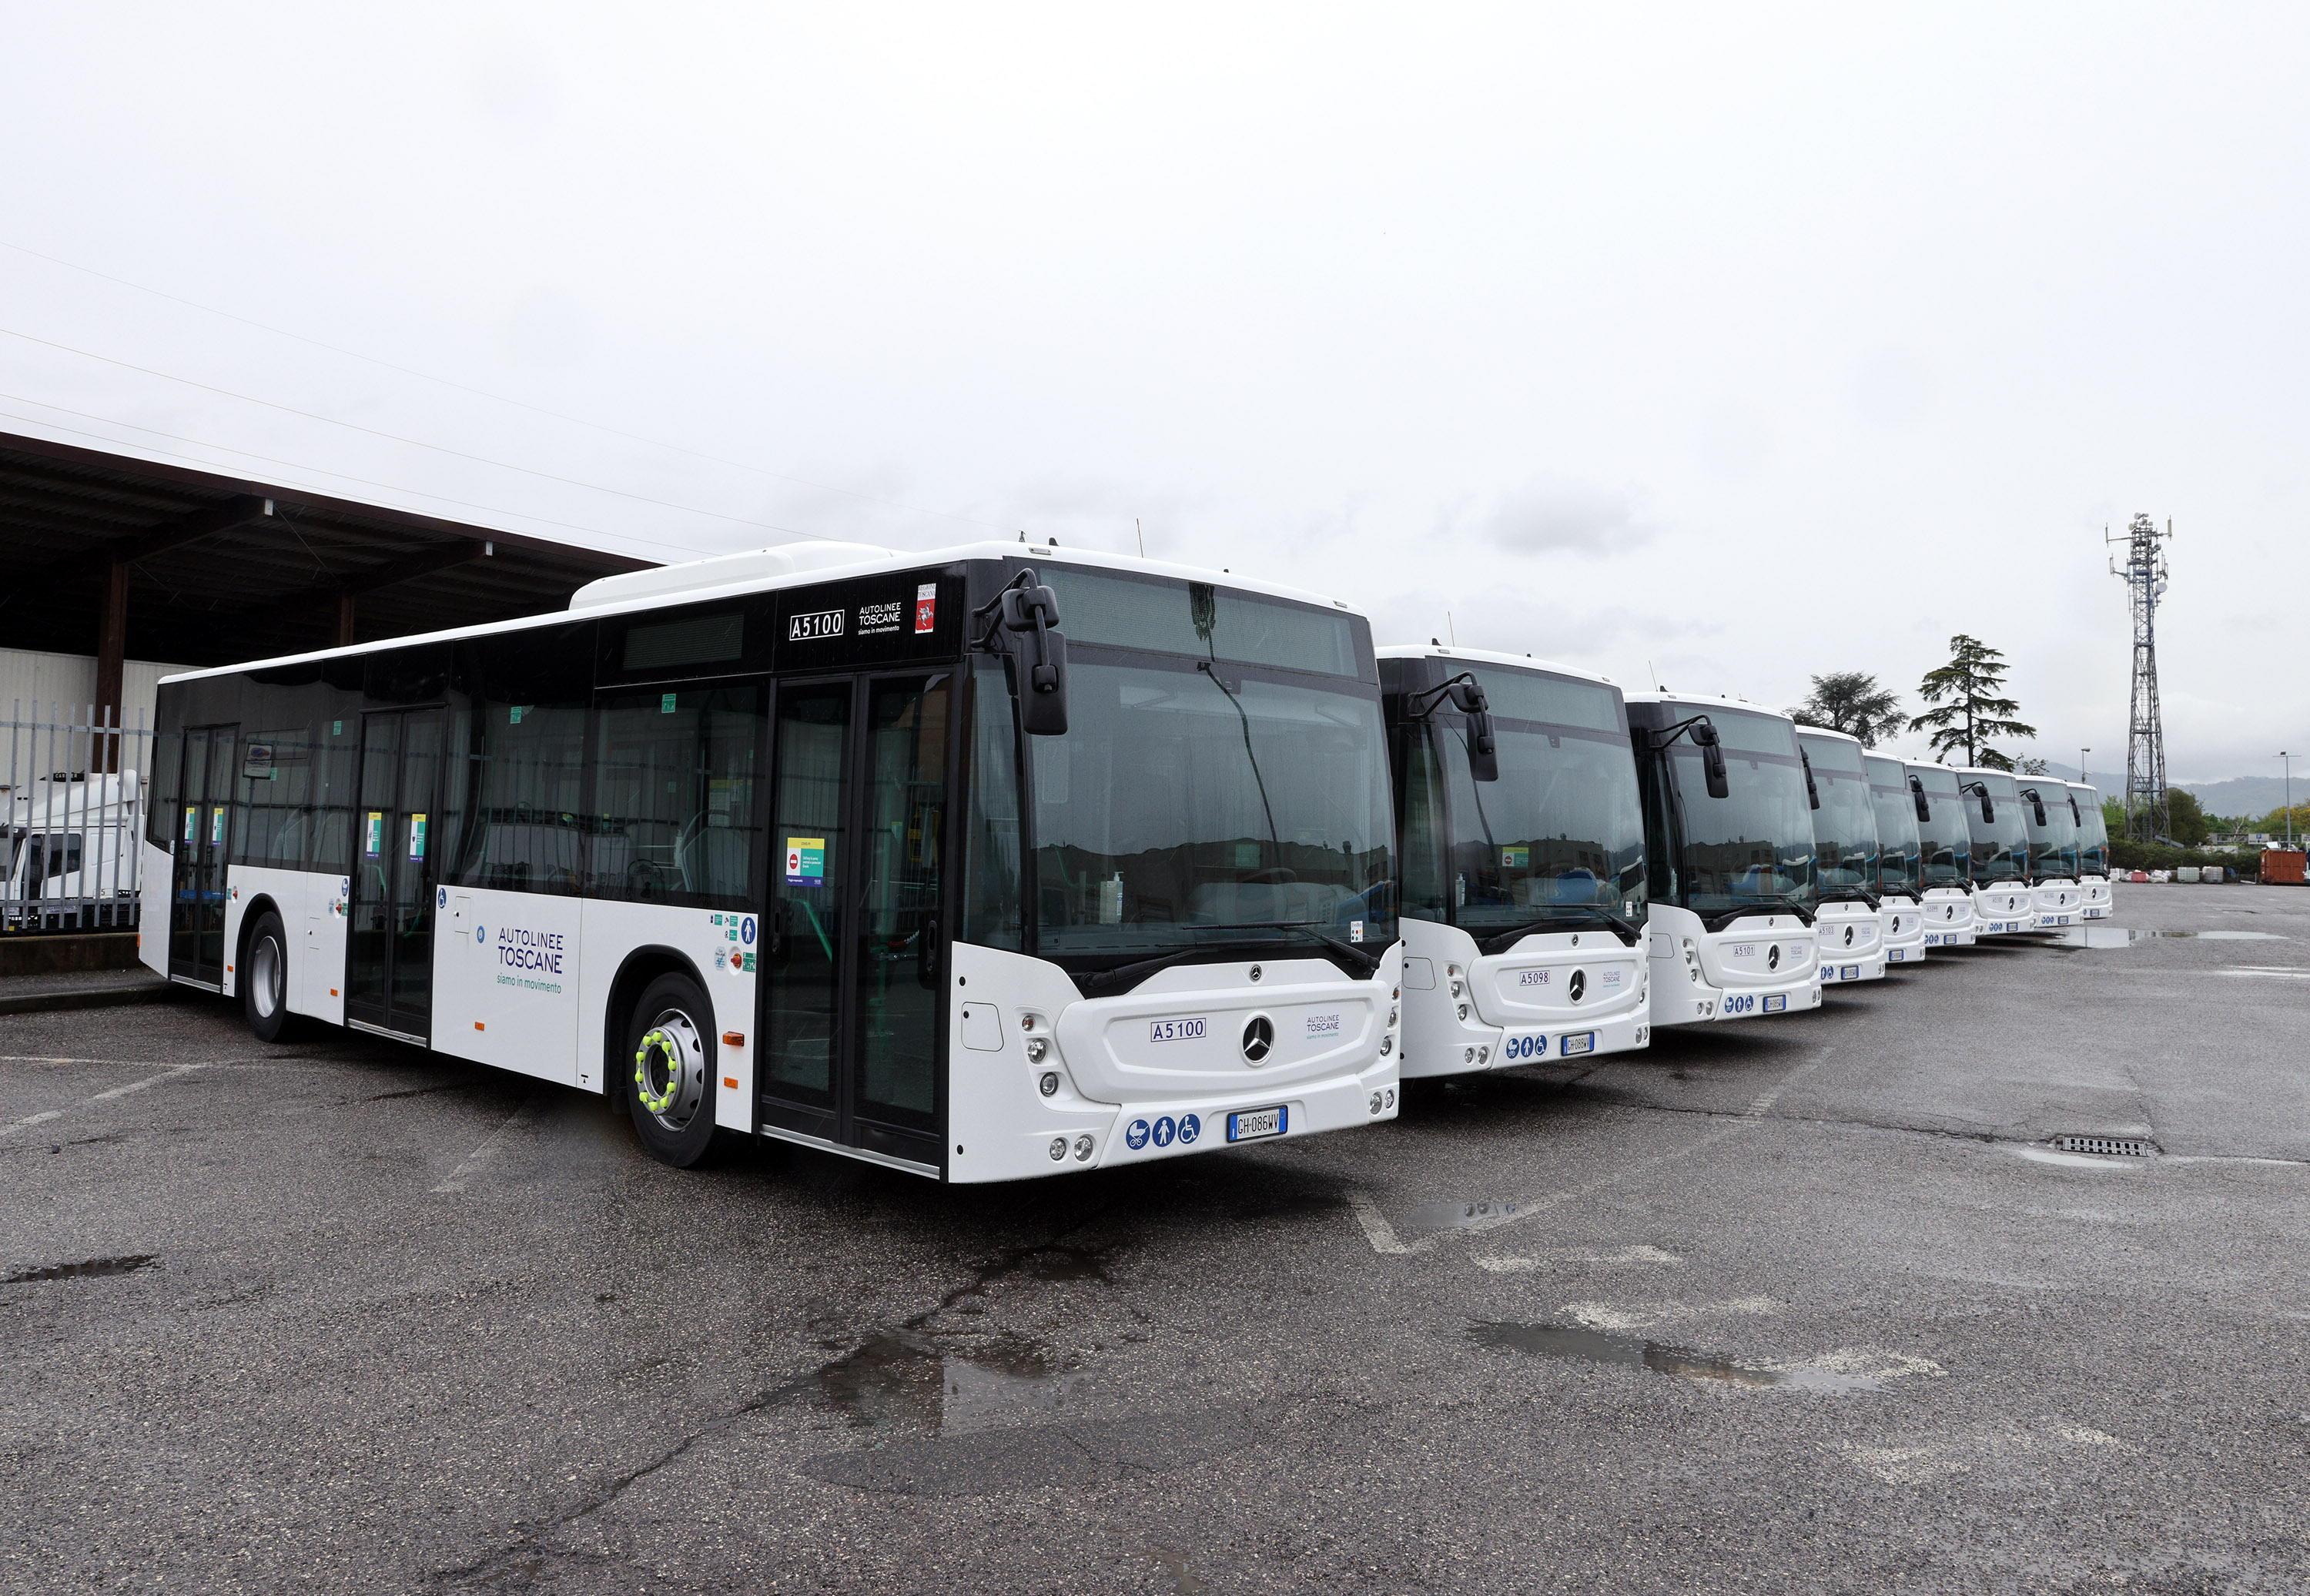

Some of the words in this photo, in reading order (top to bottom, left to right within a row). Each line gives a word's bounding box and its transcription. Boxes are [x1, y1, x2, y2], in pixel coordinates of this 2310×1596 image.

[859, 602, 902, 615] AUTOLINEE
[791, 612, 842, 638] A5100
[859, 611, 901, 626] TOSCANE
[875, 625, 900, 634] movimento
[498, 927, 564, 950] AUTOLINEE
[1734, 945, 1754, 955] A5101
[498, 945, 563, 974] TOSCANE
[497, 972, 516, 986] siamo
[517, 975, 523, 987] in
[524, 979, 562, 994] movimento
[1521, 972, 1549, 985] A5098
[1307, 1015, 1340, 1023] AUTOLINEE
[1153, 1020, 1204, 1040] A5100
[1307, 1022, 1339, 1032] TOSCANE
